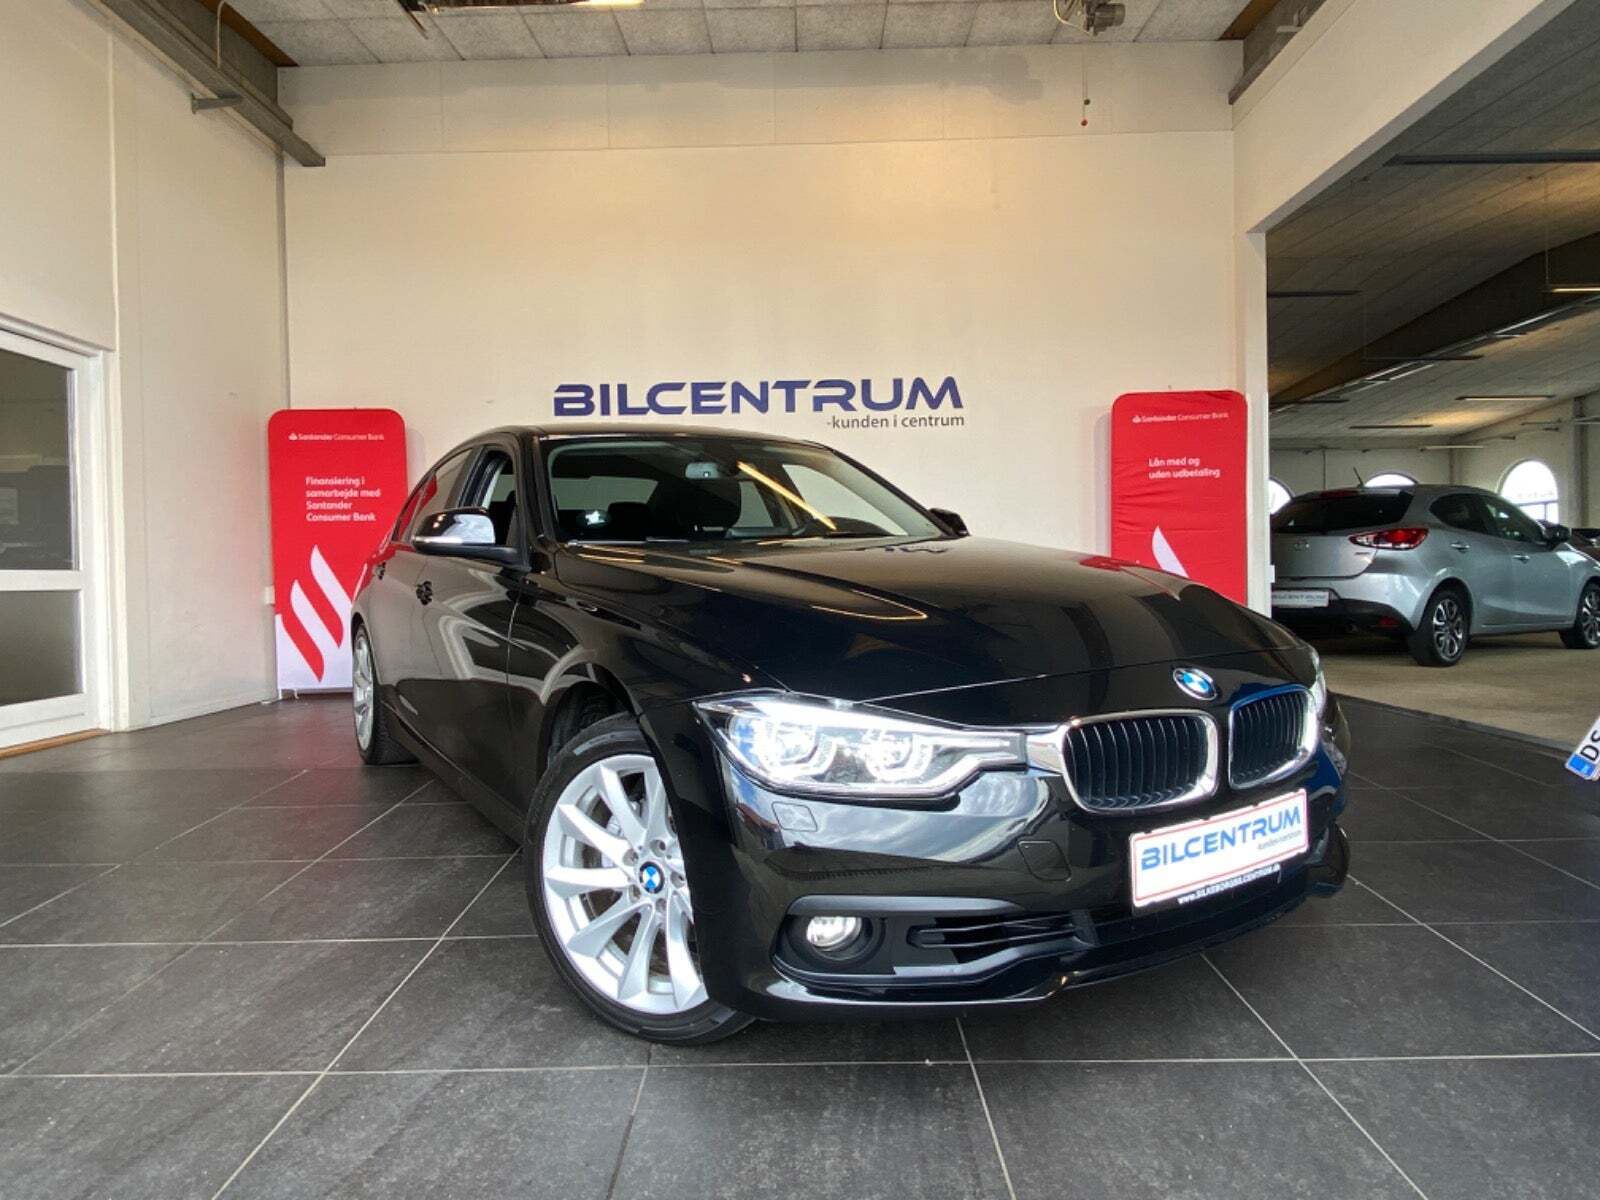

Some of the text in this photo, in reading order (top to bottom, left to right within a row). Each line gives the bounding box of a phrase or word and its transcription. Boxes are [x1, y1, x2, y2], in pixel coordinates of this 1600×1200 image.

[553, 375, 964, 416] BILCENTRUM
[826, 414, 965, 429] -kunden i centrum
[368, 432, 385, 441] Bank
[1148, 456, 1201, 468] Lån med og
[1148, 467, 1221, 480] uden udbetaling
[305, 476, 360, 488] Finansiering
[305, 488, 382, 500] samarbejde med
[305, 500, 353, 511] Santander
[305, 512, 377, 522] Consumer Bank
[1140, 806, 1301, 871] BILCENTRUM
